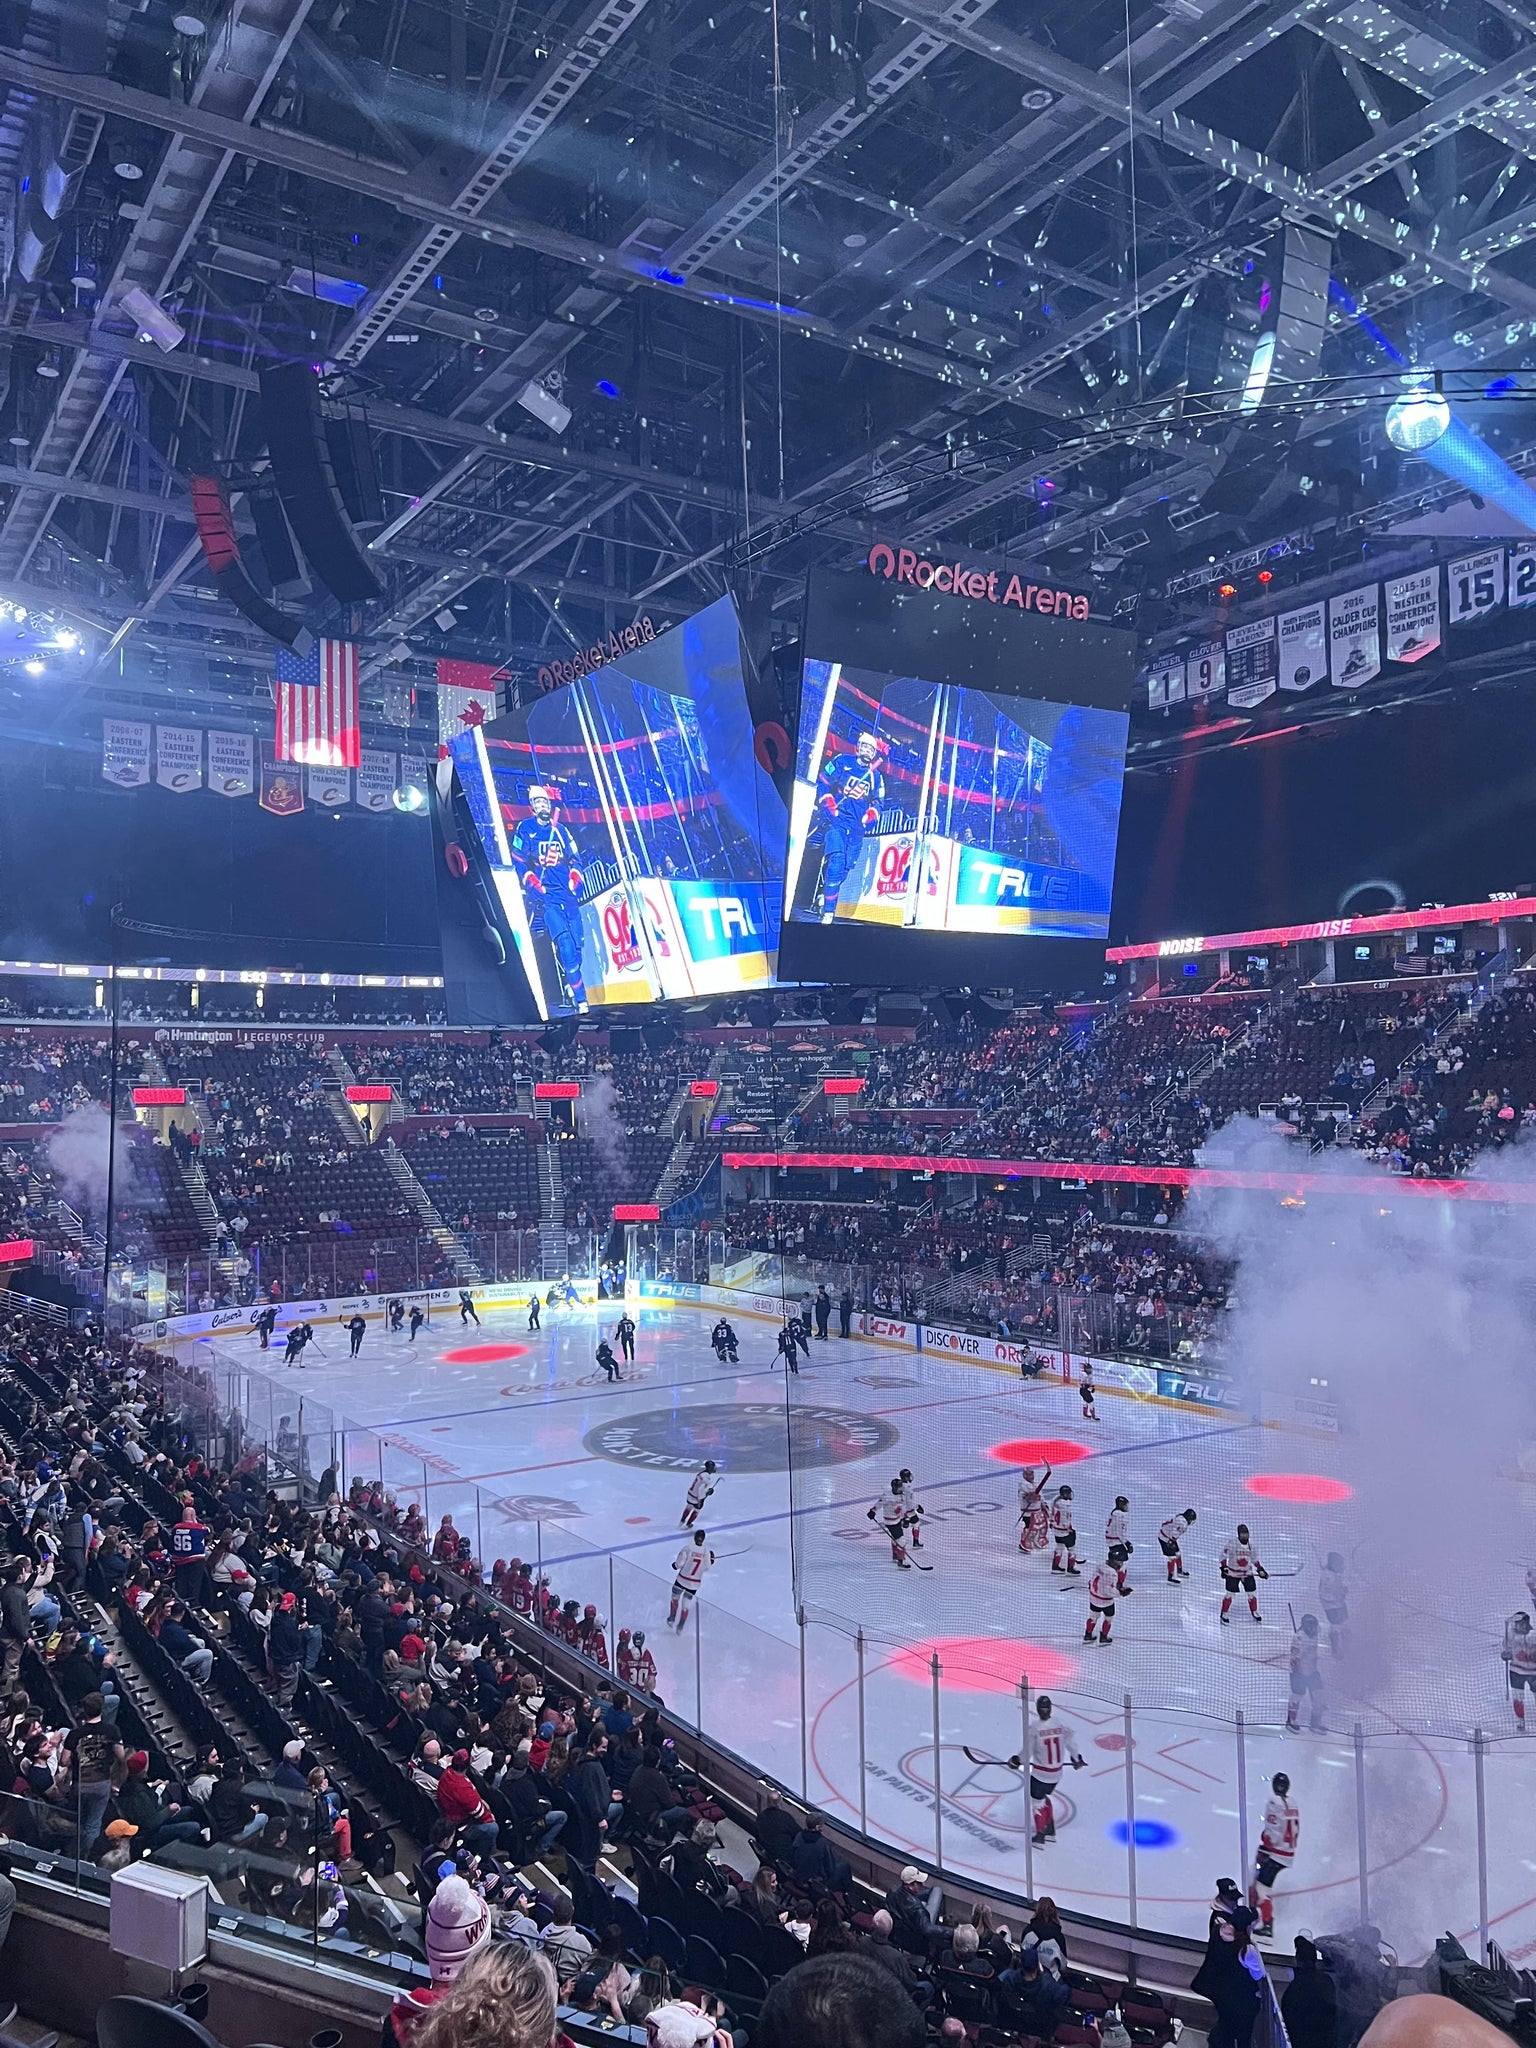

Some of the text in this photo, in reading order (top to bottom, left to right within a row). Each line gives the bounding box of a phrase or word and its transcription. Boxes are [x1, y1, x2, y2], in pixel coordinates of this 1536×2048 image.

[897, 548, 1089, 621] Rocket Arena
[1458, 569, 1495, 613] 15
[1394, 591, 1431, 609] WESTERN
[1332, 604, 1377, 627] CALDER CUP
[1388, 601, 1438, 623] CONFERENCE
[1228, 620, 1272, 639] CLEVELAND
[1281, 616, 1321, 636] CHAMPIONS
[1332, 618, 1377, 640] CHAMPIONS
[1391, 615, 1435, 635] CHAMPIONS
[1236, 630, 1266, 645] BARONS
[550, 616, 655, 686] Rocket Arena
[1189, 641, 1222, 658] GLOVER
[1200, 660, 1211, 689] 9
[1162, 672, 1170, 700] 1
[111, 736, 142, 746] EASTERN
[163, 732, 195, 742] 2014-15
[106, 746, 147, 756] CONFERENCE
[160, 751, 199, 761] CONFERENCE
[164, 743, 194, 752] EASTERN
[216, 747, 245, 757] EASTERN
[107, 755, 146, 765] CHAMPIONS
[161, 760, 198, 770] CHAMPIONS
[211, 756, 250, 766] CONFERENCE
[263, 762, 300, 773] CHAMPIONS
[213, 765, 248, 775] CHAMPIONS
[363, 765, 389, 773] EASTERN
[404, 765, 424, 773] CHAMP
[312, 775, 346, 784] CHAMPIONS
[360, 781, 393, 790] CHAMPIONS
[970, 861, 1071, 901] TRUE
[1159, 937, 1205, 957] NOISE
[170, 1028, 325, 1044] Huntington LEGENDS CLUB
[643, 1282, 696, 1297] TRUE
[212, 1309, 242, 1328] Culver's
[623, 1323, 633, 1332] 13
[717, 1328, 727, 1338] 33
[926, 1330, 980, 1355] DISCOVER
[1007, 1346, 1056, 1371] Roket
[744, 1405, 880, 1446] CLEVELAND
[602, 1427, 725, 1468] MONSTERS
[173, 1535, 192, 1551] 96
[691, 1559, 702, 1576] 7
[512, 1591, 525, 1609] 19
[628, 1668, 649, 1687] 30
[1043, 1737, 1061, 1764] 11
[864, 1760, 1017, 1853] CAR PARTS WAREHOUSE
